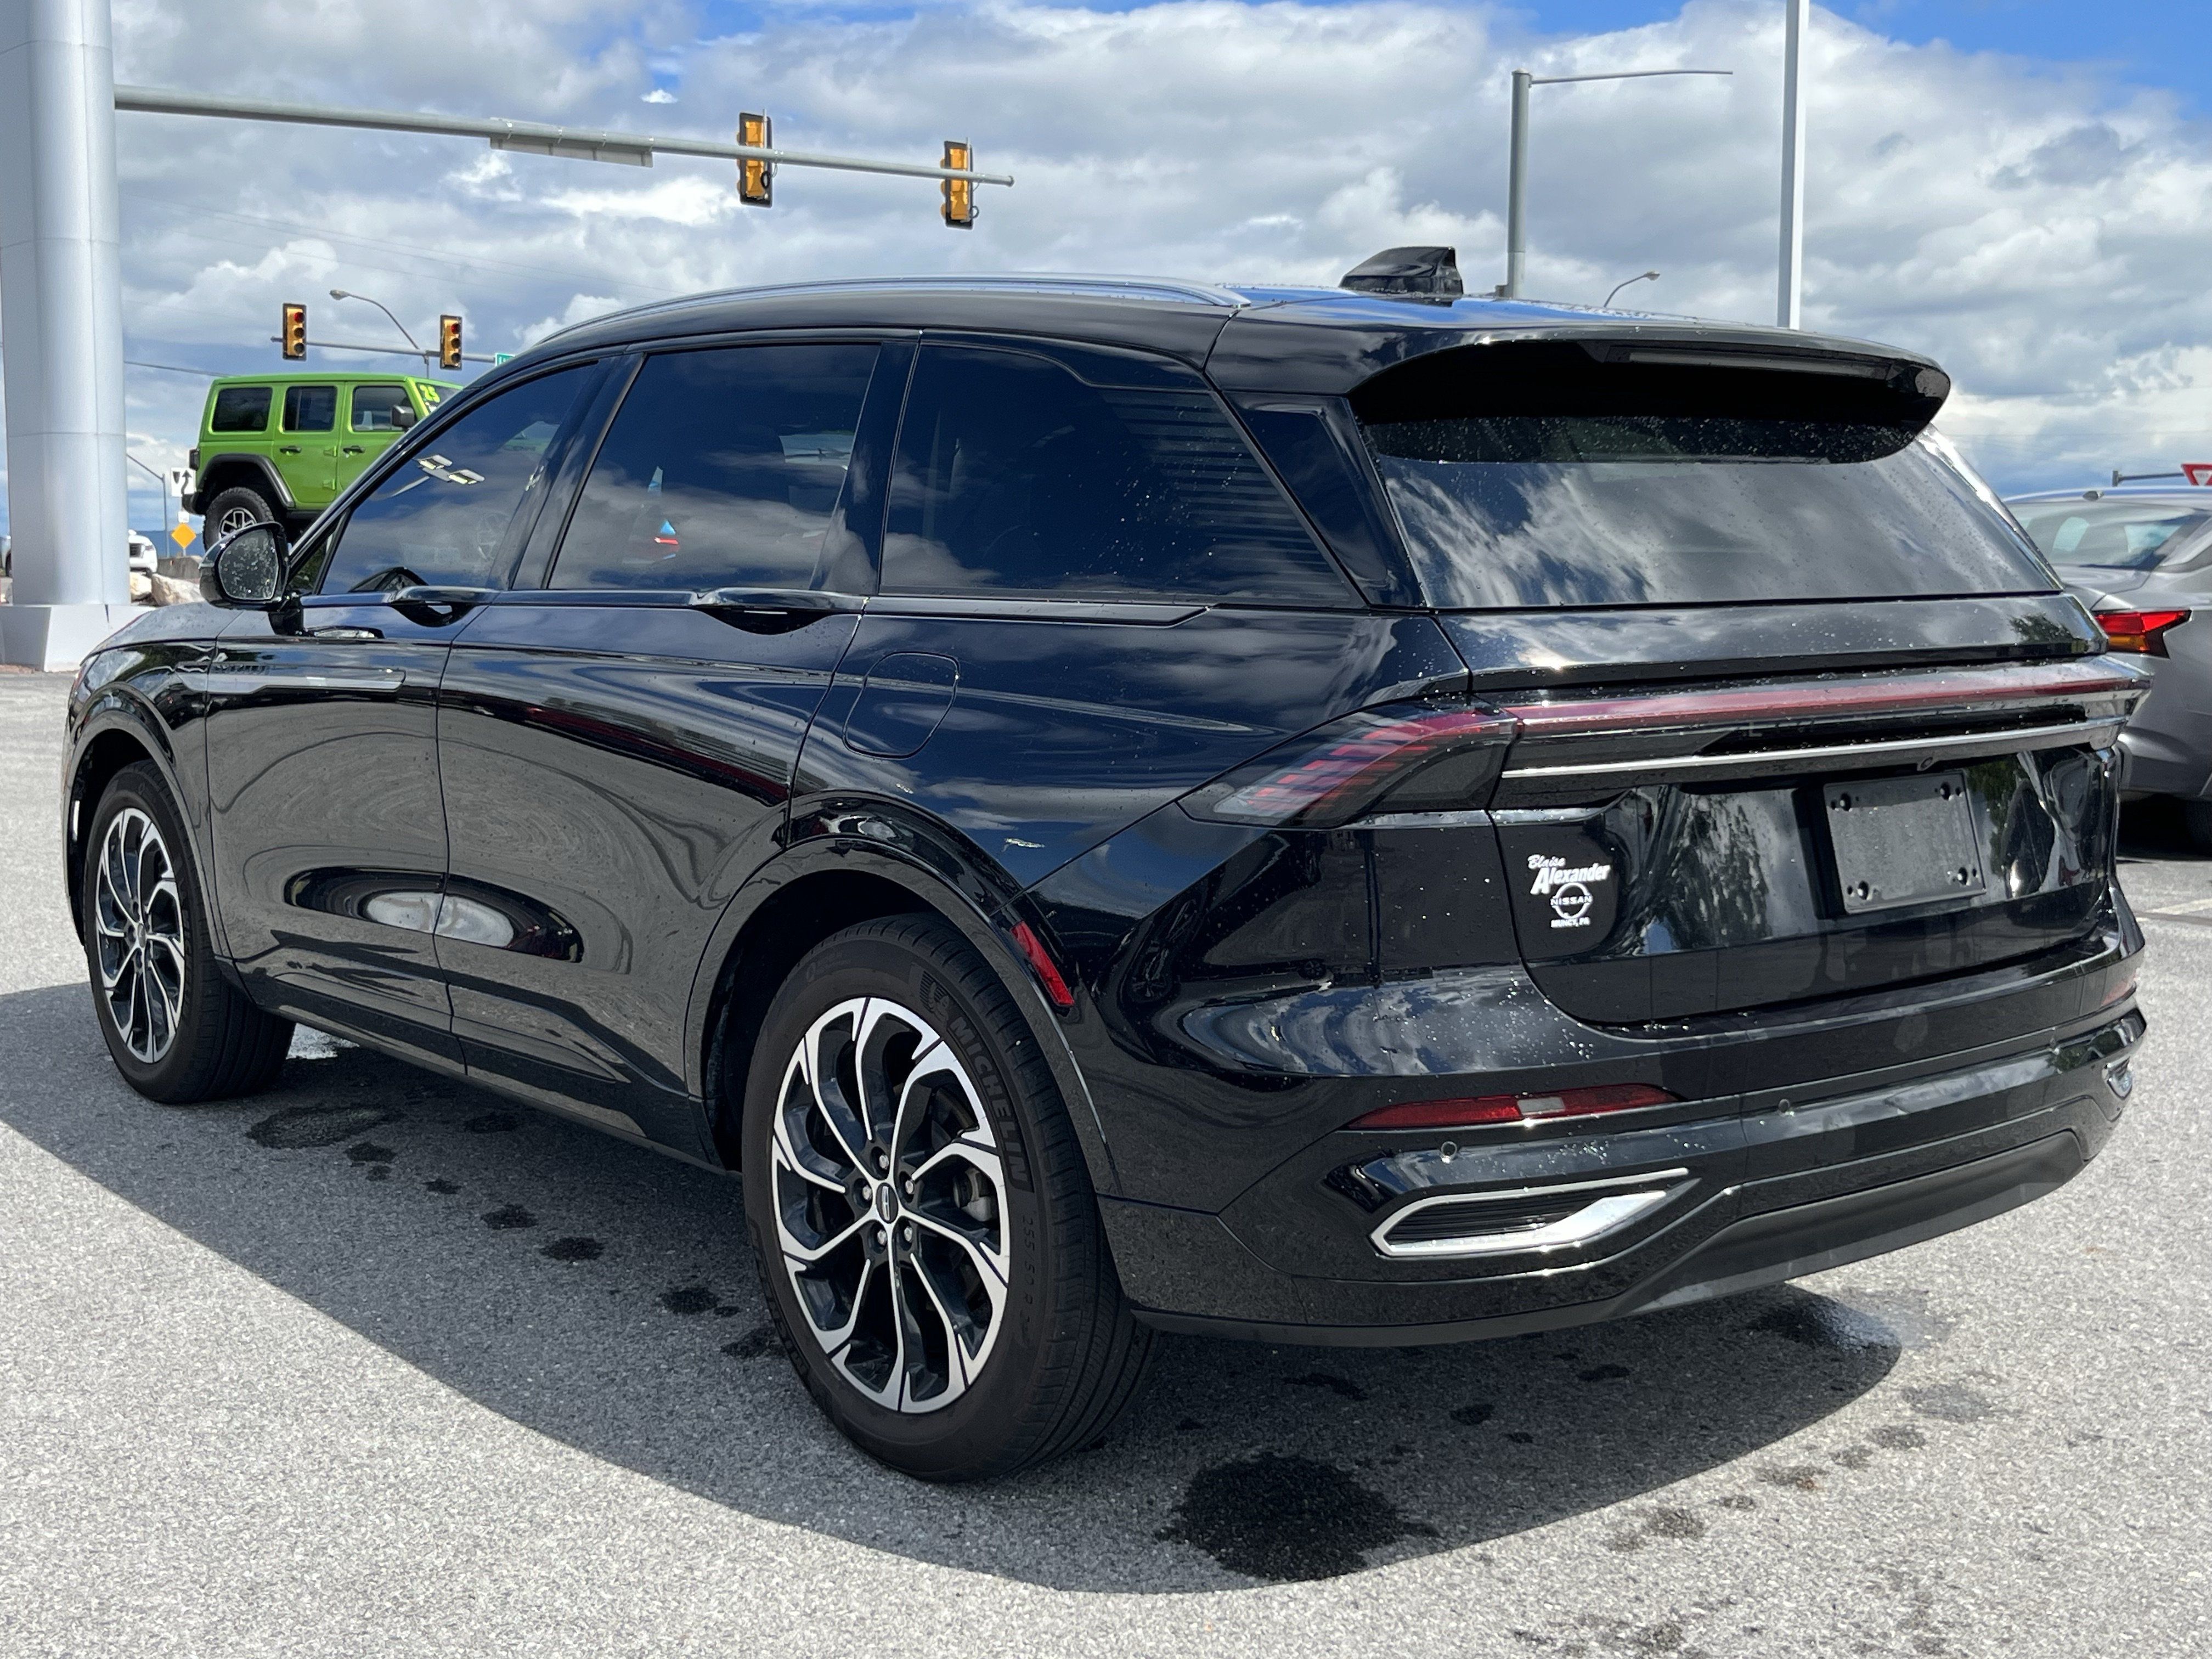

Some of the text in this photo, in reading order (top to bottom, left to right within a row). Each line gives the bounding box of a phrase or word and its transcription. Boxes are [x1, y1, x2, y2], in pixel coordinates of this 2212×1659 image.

[420, 385, 440, 403] 25
[1528, 854, 1566, 869] Blaise
[1530, 863, 1611, 895] Alexander
[1550, 895, 1593, 906] NISSAN
[950, 1016, 1029, 1182] MICHELIN
[1023, 1215, 1035, 1285] 255/50
